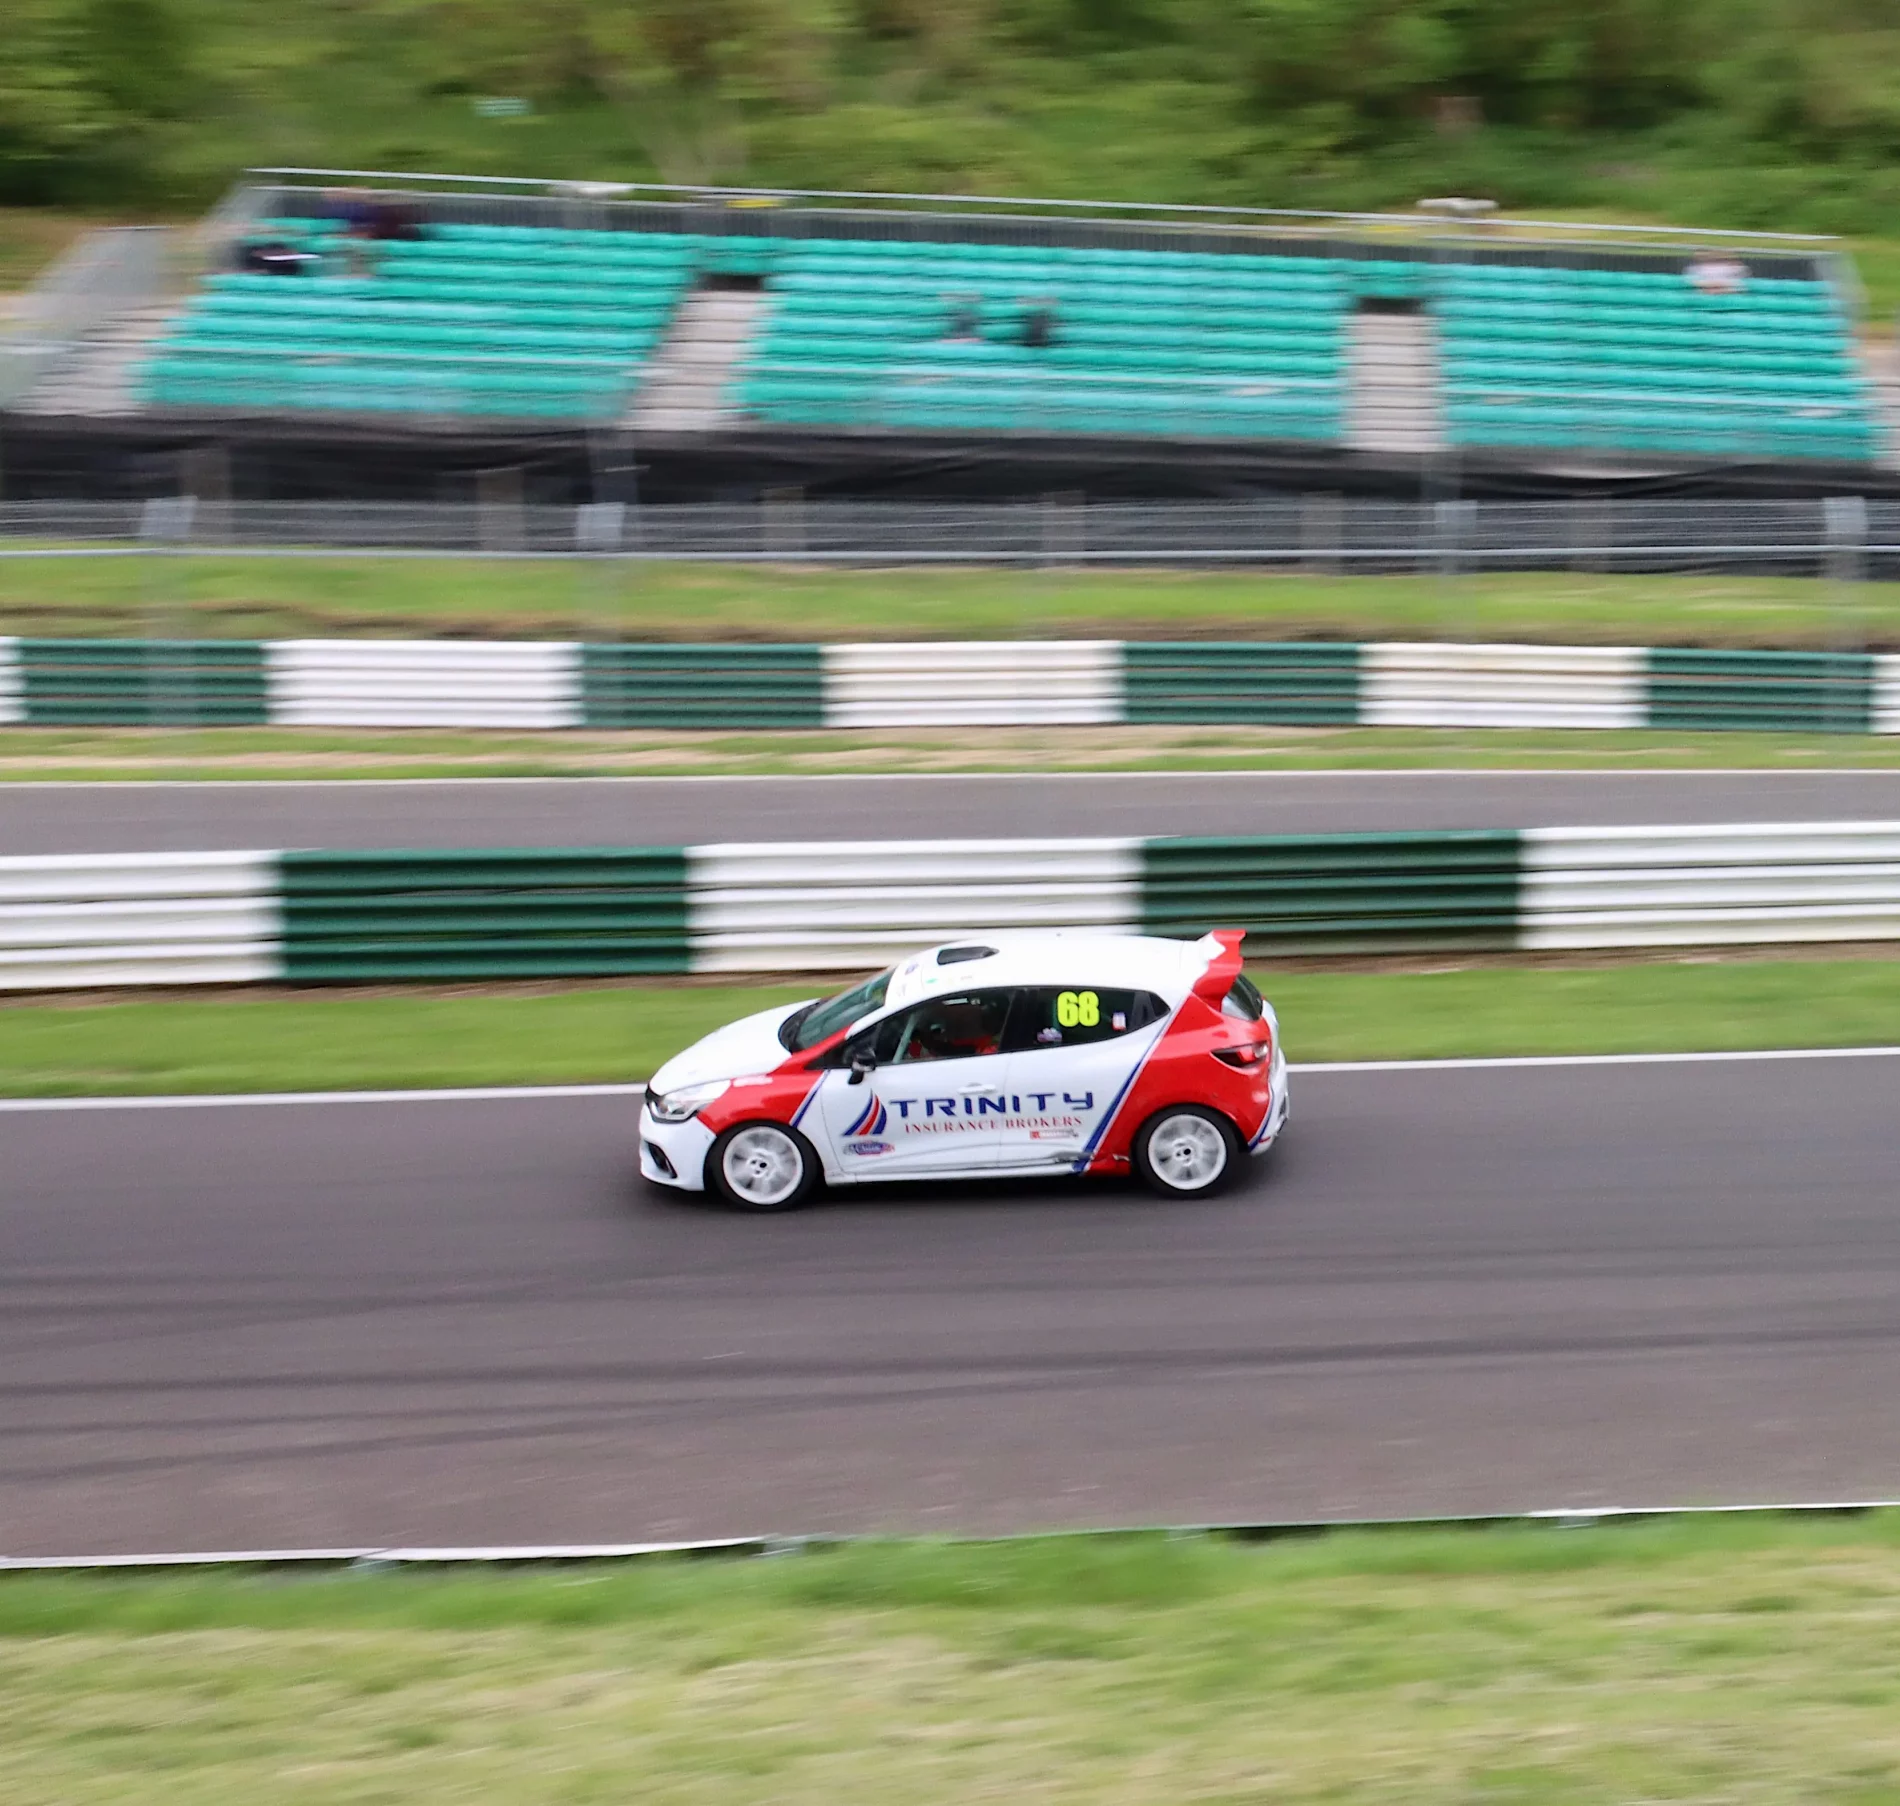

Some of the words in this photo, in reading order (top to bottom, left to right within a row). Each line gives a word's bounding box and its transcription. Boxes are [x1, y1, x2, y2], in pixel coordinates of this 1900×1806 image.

[1057, 991, 1099, 1027] 68
[889, 1091, 1094, 1118] TRINITY
[905, 1120, 997, 1134] INSURANCE
[1005, 1116, 1083, 1128] BROKERS
